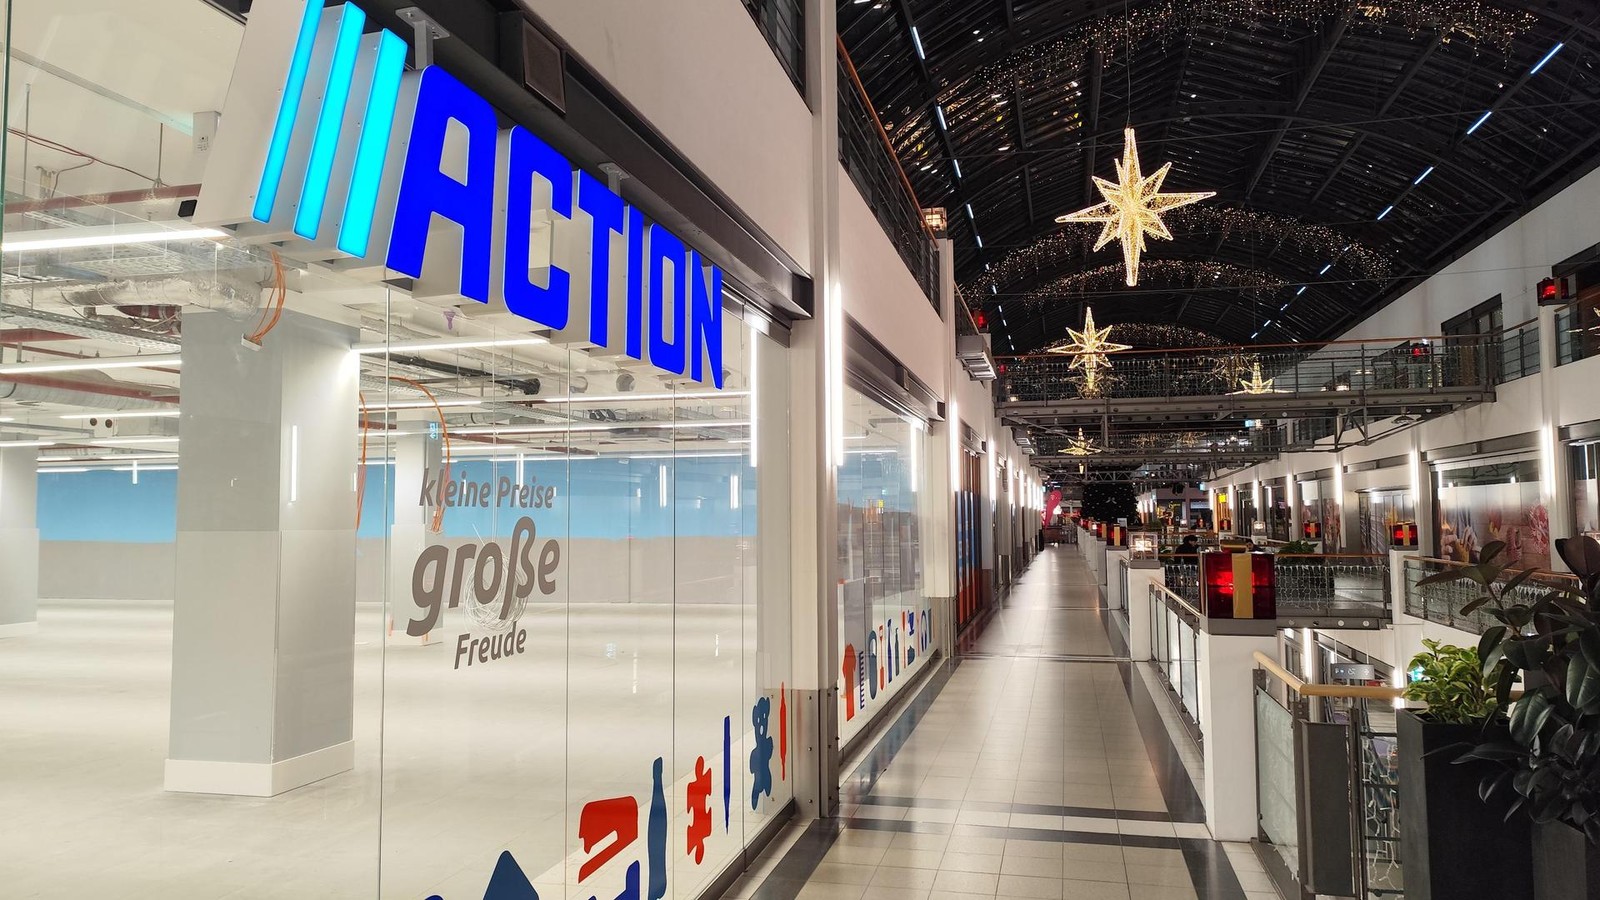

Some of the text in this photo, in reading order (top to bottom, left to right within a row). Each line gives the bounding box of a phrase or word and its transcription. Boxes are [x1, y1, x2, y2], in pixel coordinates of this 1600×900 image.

[386, 65, 723, 389] ACTION
[419, 467, 554, 509] kleine Preise
[406, 516, 560, 637] große
[454, 621, 527, 670] Freude
